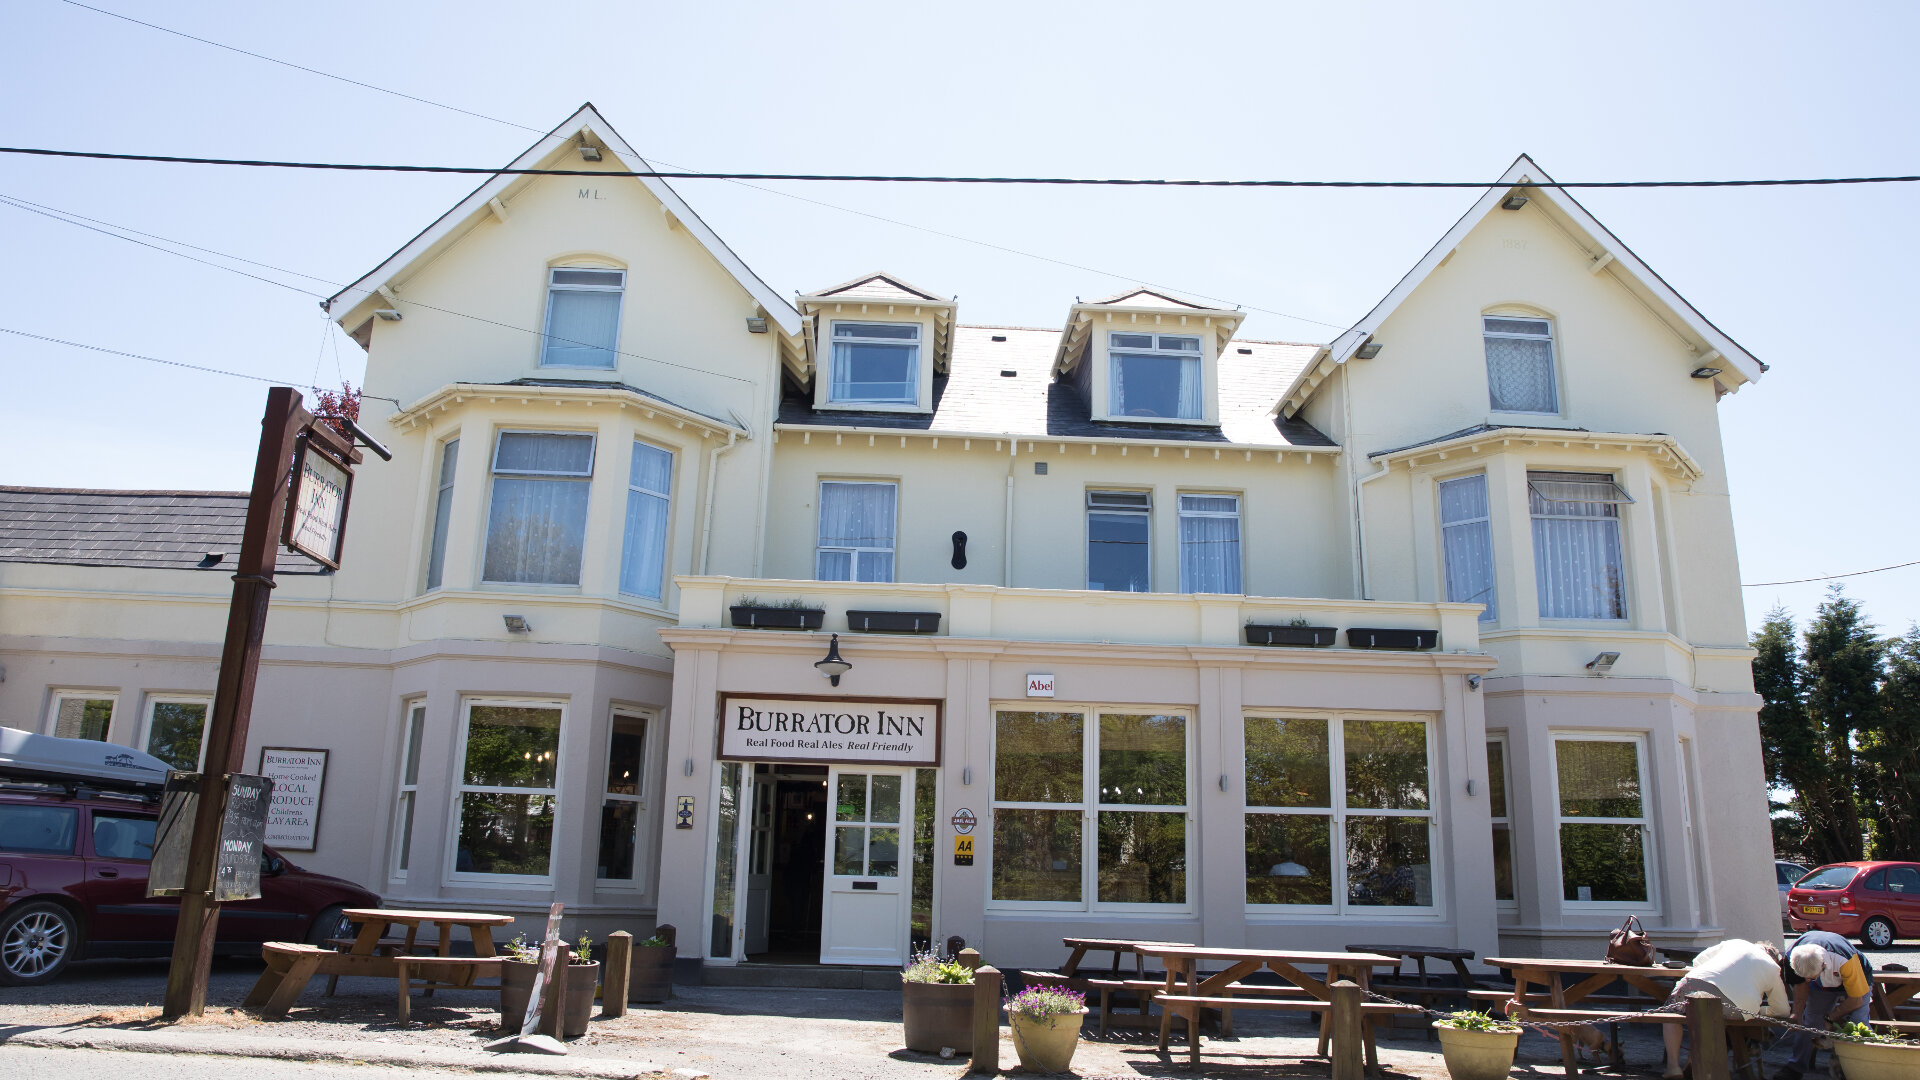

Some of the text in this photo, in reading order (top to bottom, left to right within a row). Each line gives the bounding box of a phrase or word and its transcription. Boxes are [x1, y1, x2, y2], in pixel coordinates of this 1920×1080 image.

[579, 188, 589, 199] M
[311, 488, 326, 509] INN
[1028, 680, 1053, 691] Abel
[737, 705, 925, 737] BURRATOR INN
[746, 737, 914, 754] Real Food Real Ales Real Friendly
[307, 756, 322, 766] INN
[268, 772, 317, 782] Home Cooked
[232, 784, 262, 800] SUNDAY
[272, 783, 308, 793] LOCAL
[271, 795, 315, 806] RODUCE
[271, 807, 303, 816] Childrens
[267, 816, 309, 826] LAY AREA
[223, 839, 253, 854] MONDAY
[957, 840, 972, 851] AA
